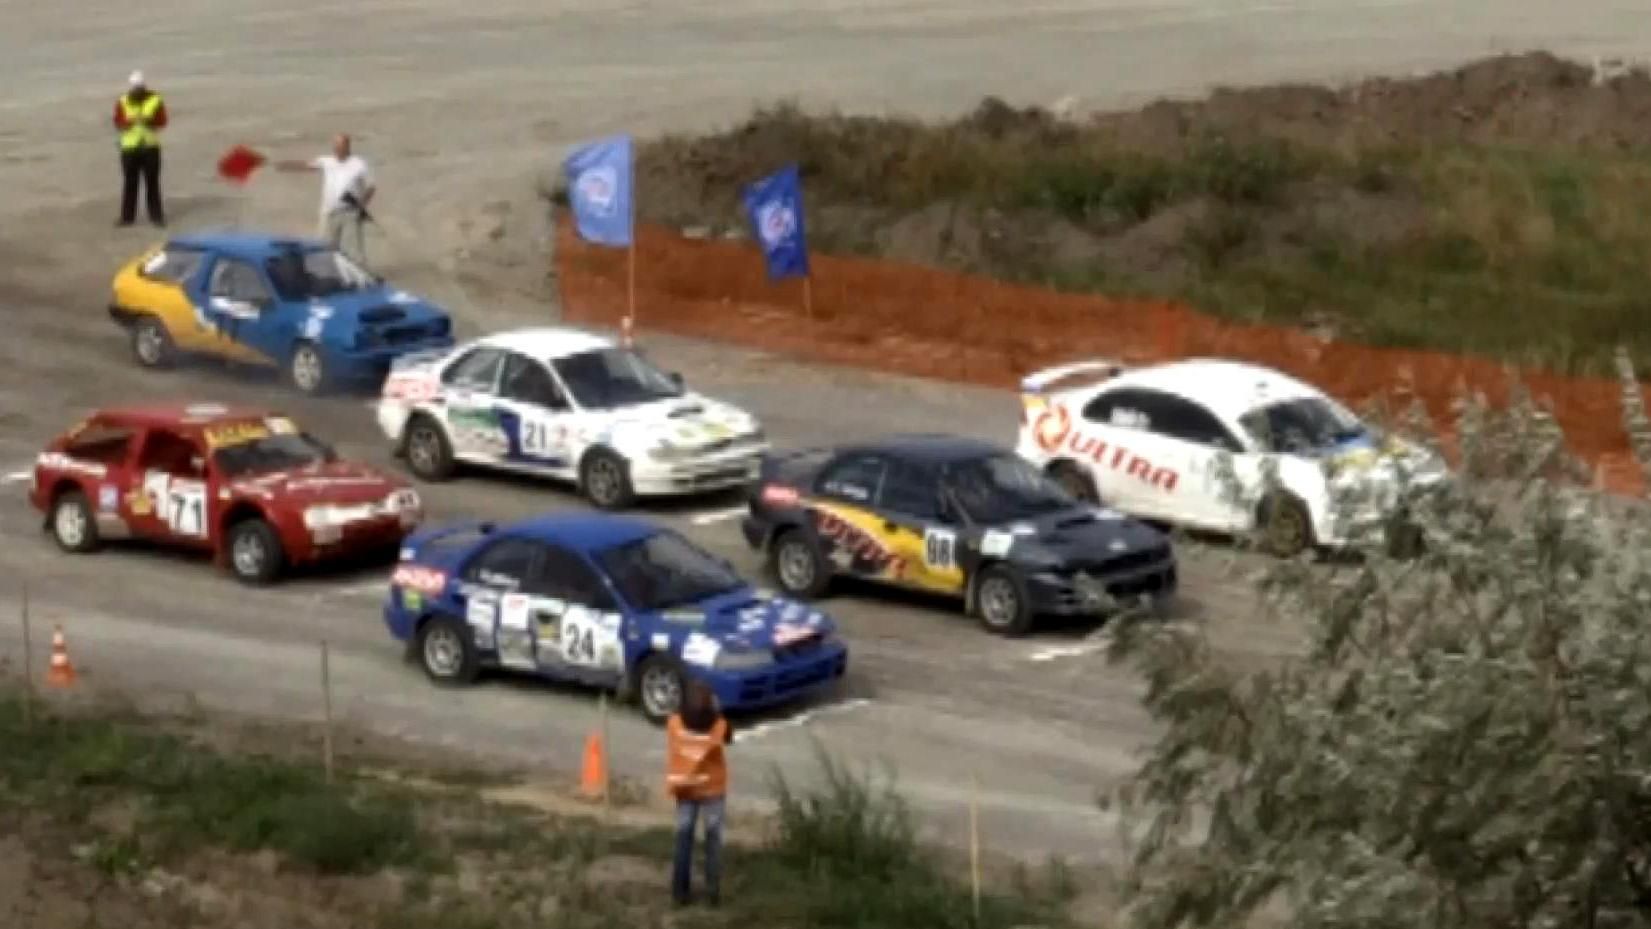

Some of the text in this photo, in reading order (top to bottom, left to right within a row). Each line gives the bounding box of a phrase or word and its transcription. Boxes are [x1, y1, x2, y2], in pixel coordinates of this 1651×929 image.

[525, 421, 547, 449] 21
[170, 491, 202, 531] 71
[565, 622, 595, 660] 24
